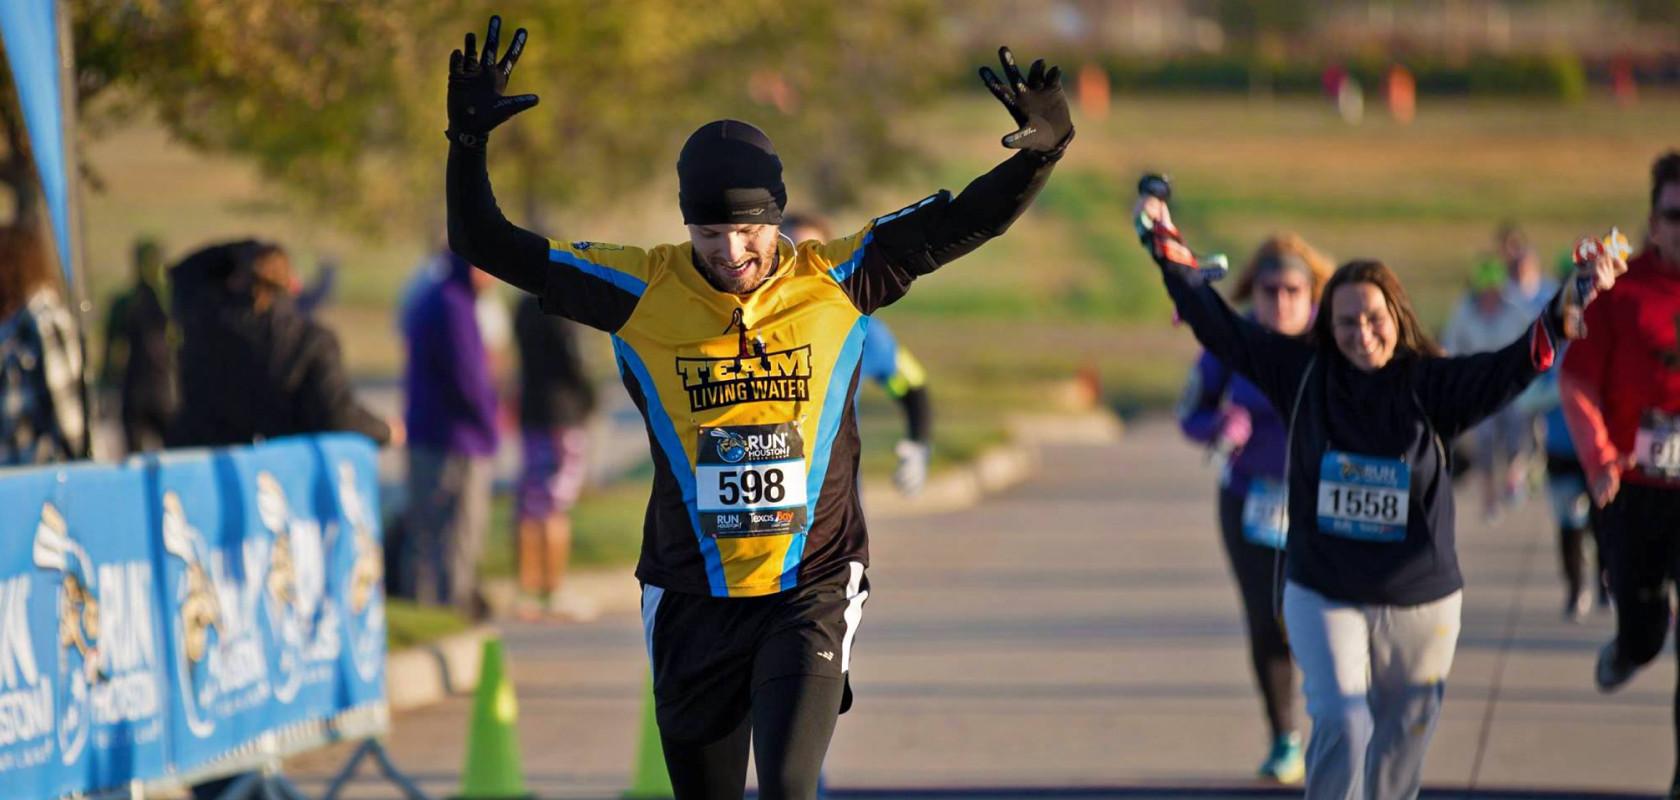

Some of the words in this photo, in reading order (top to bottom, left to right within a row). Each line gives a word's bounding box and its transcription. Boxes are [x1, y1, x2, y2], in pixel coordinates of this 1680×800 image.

[678, 350, 809, 386] TEAM
[693, 382, 747, 408] LIVING
[750, 379, 805, 399] WATER
[748, 432, 785, 450] RUN
[748, 446, 790, 457] HOUSTON!
[719, 468, 785, 505] 598
[1329, 488, 1398, 520] 1558
[717, 515, 739, 525] RUN
[749, 511, 773, 523] Texas
[774, 511, 794, 523] Bay
